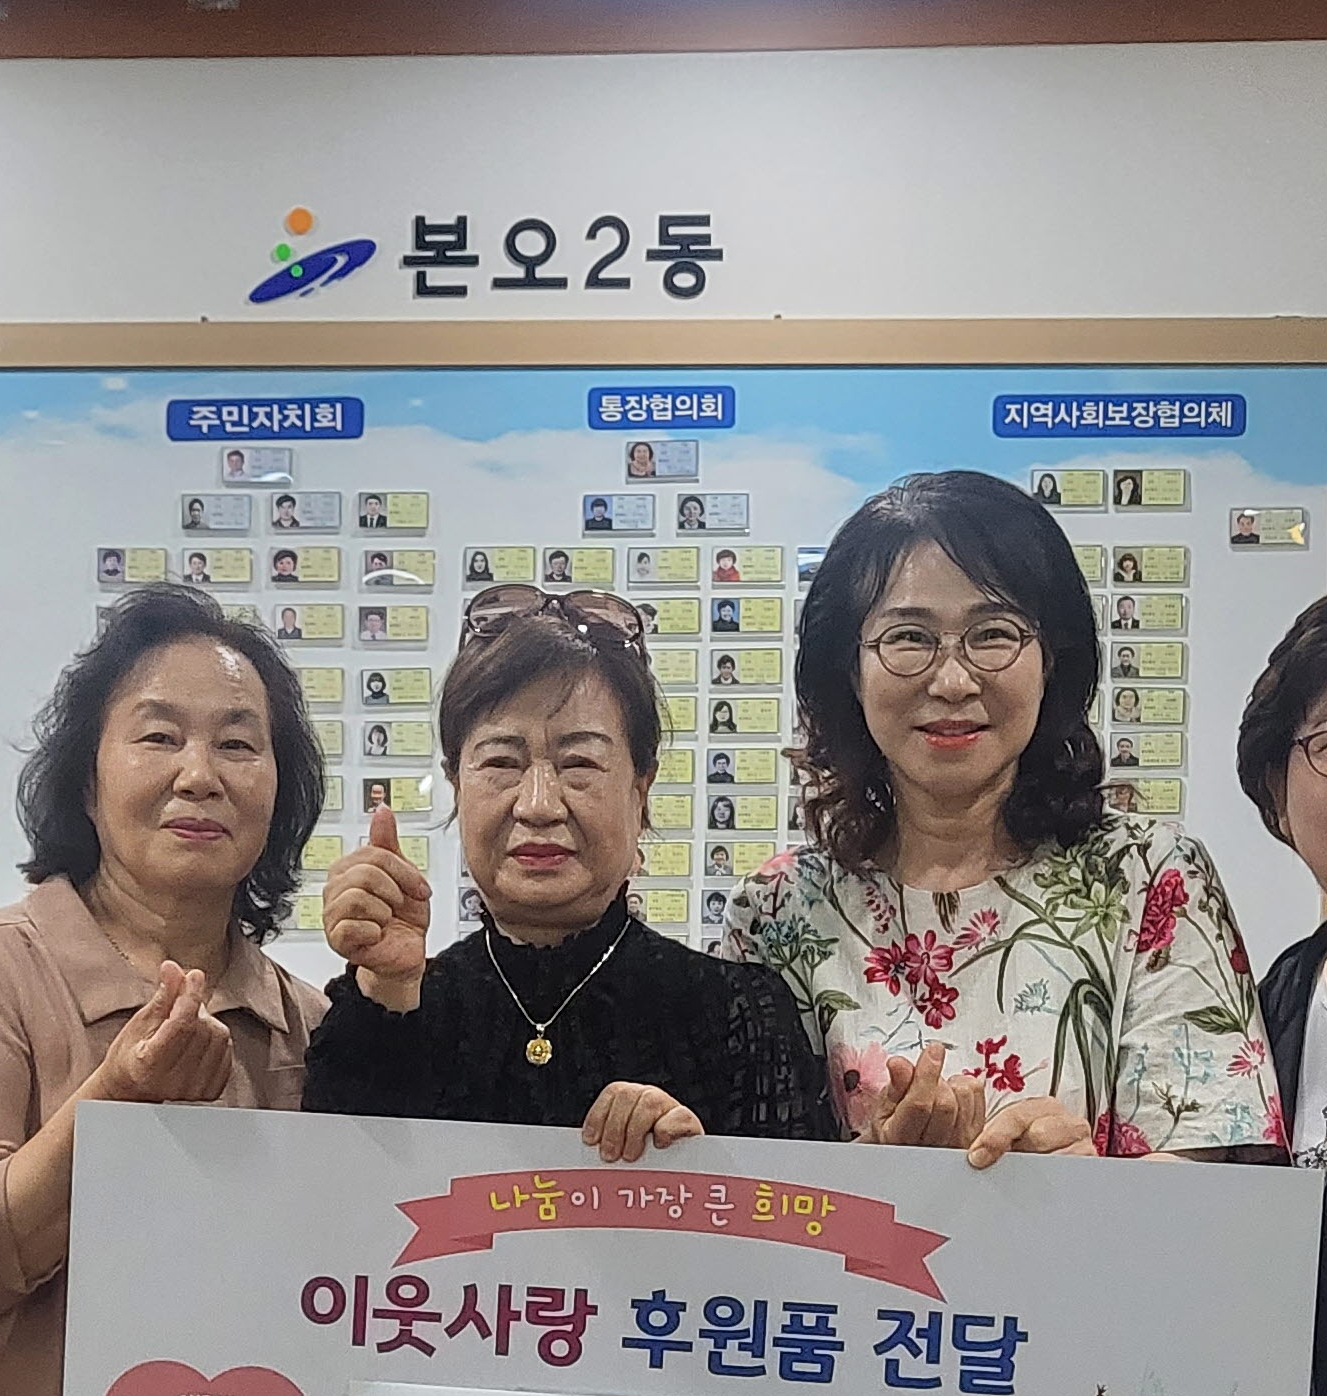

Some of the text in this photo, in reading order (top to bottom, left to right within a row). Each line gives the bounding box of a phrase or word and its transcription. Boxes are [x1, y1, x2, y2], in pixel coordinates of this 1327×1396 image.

[401, 214, 724, 299] 본오2동
[189, 403, 344, 433] 주민자치회
[599, 394, 723, 421] 통장협의회
[1004, 401, 1232, 428] 지역사회보장협의체
[488, 1176, 837, 1236] 나눔이 가장 큰 희망
[300, 1274, 1029, 1396] 이웃사랑 후원품 전달
